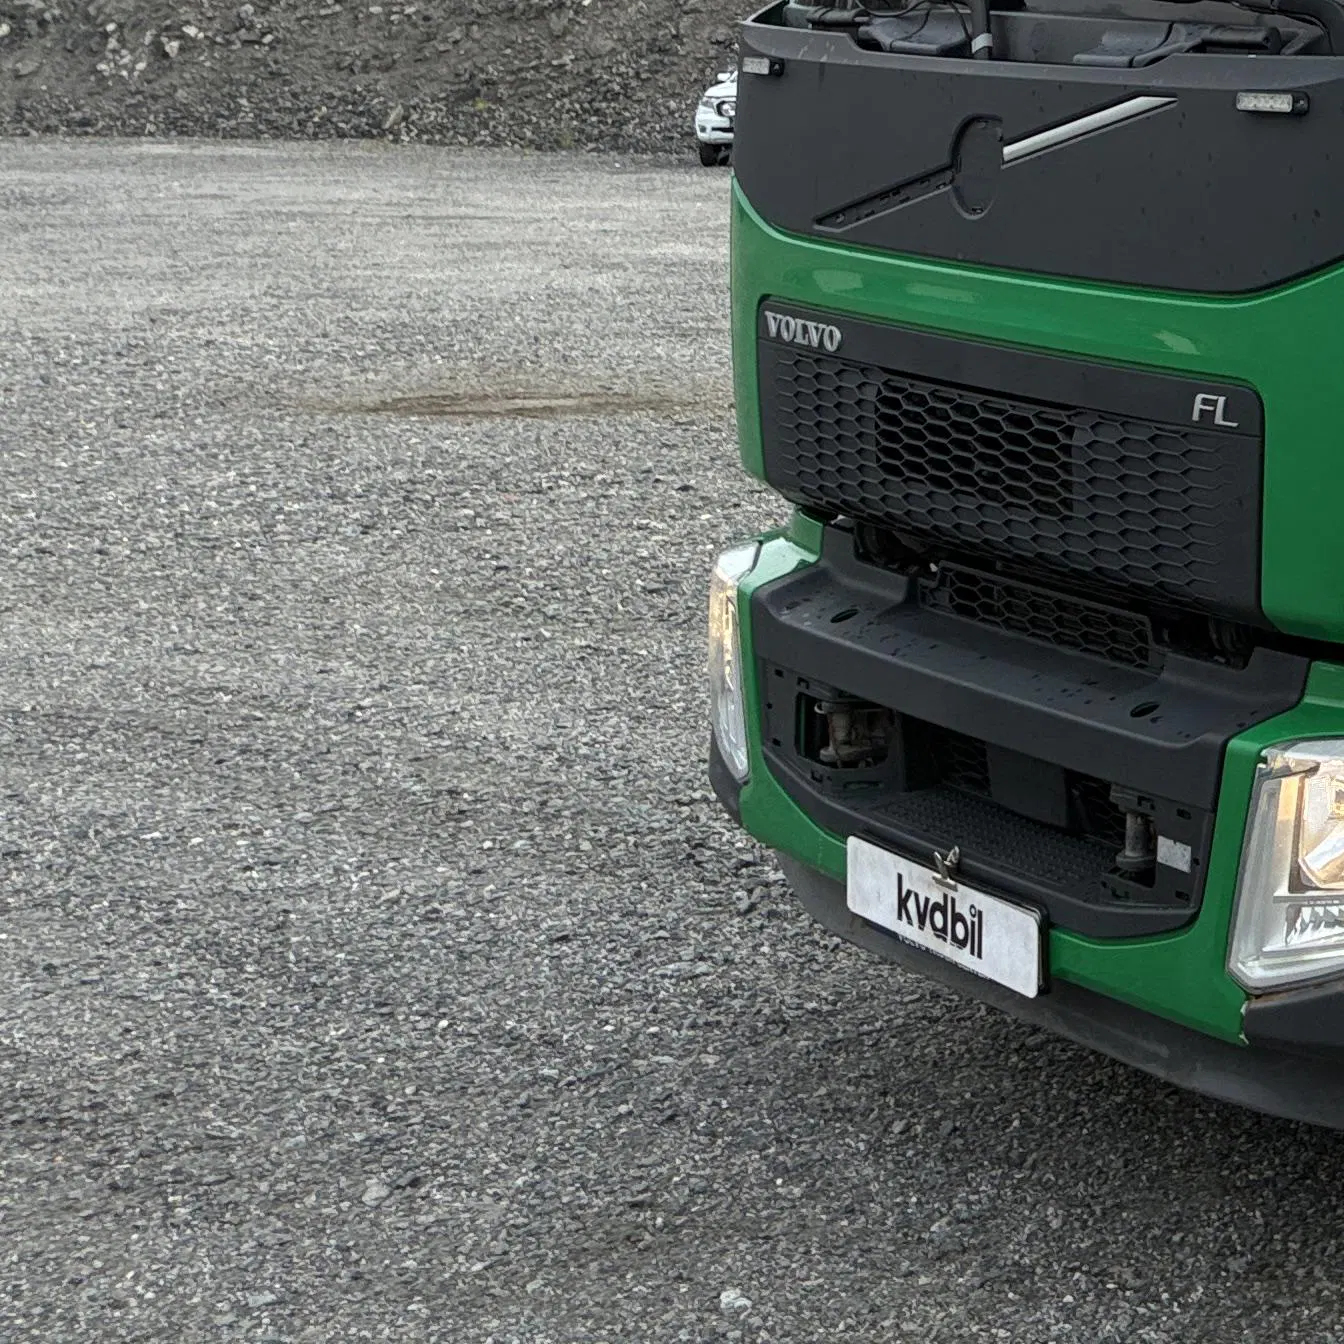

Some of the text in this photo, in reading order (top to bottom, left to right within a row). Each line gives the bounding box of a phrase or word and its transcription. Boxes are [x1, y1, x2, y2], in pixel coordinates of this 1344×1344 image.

[764, 310, 841, 352] VOLVO
[1192, 393, 1239, 427] FL
[897, 872, 983, 960] kvdbil
